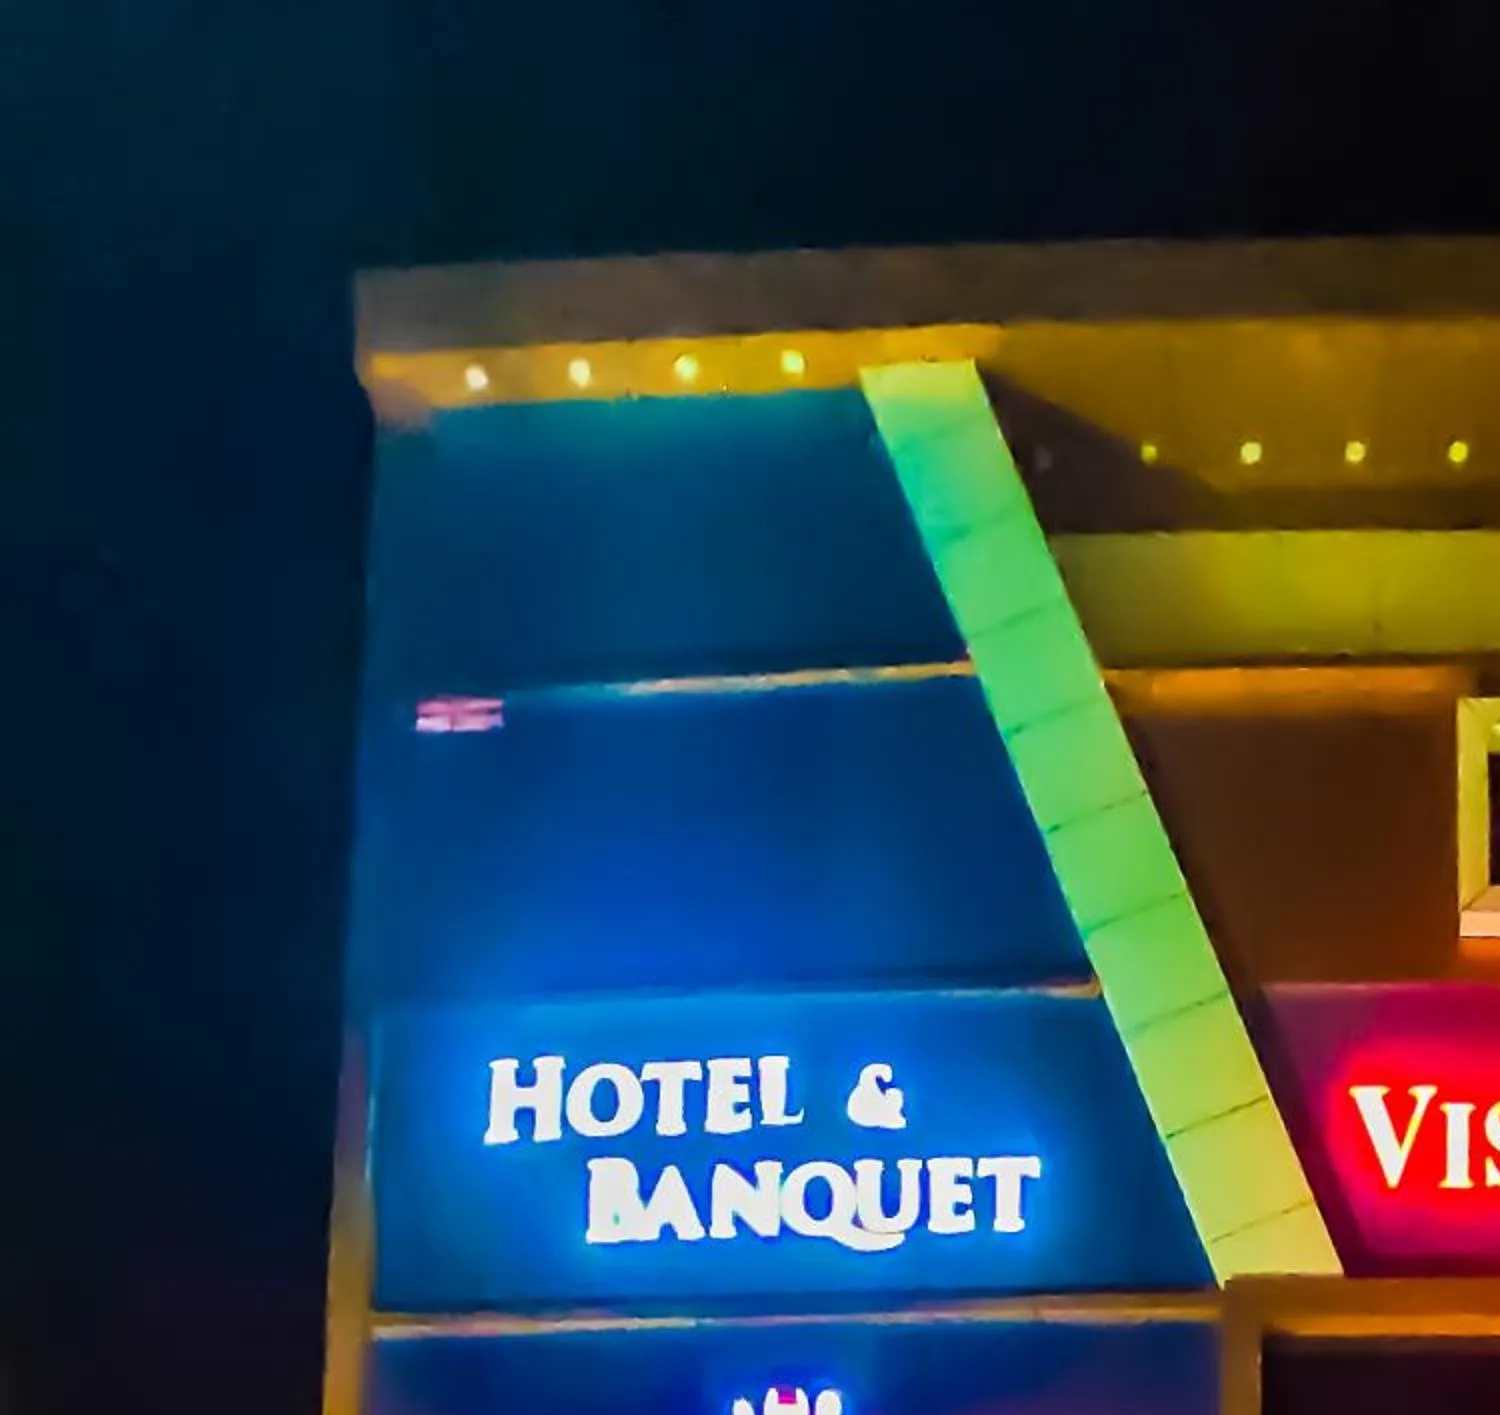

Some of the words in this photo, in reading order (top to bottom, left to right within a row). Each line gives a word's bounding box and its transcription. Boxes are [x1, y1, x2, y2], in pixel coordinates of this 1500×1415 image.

[484, 1054, 804, 1144] HOTEL
[846, 1063, 907, 1128] &
[585, 1155, 1041, 1252] BANQUET
